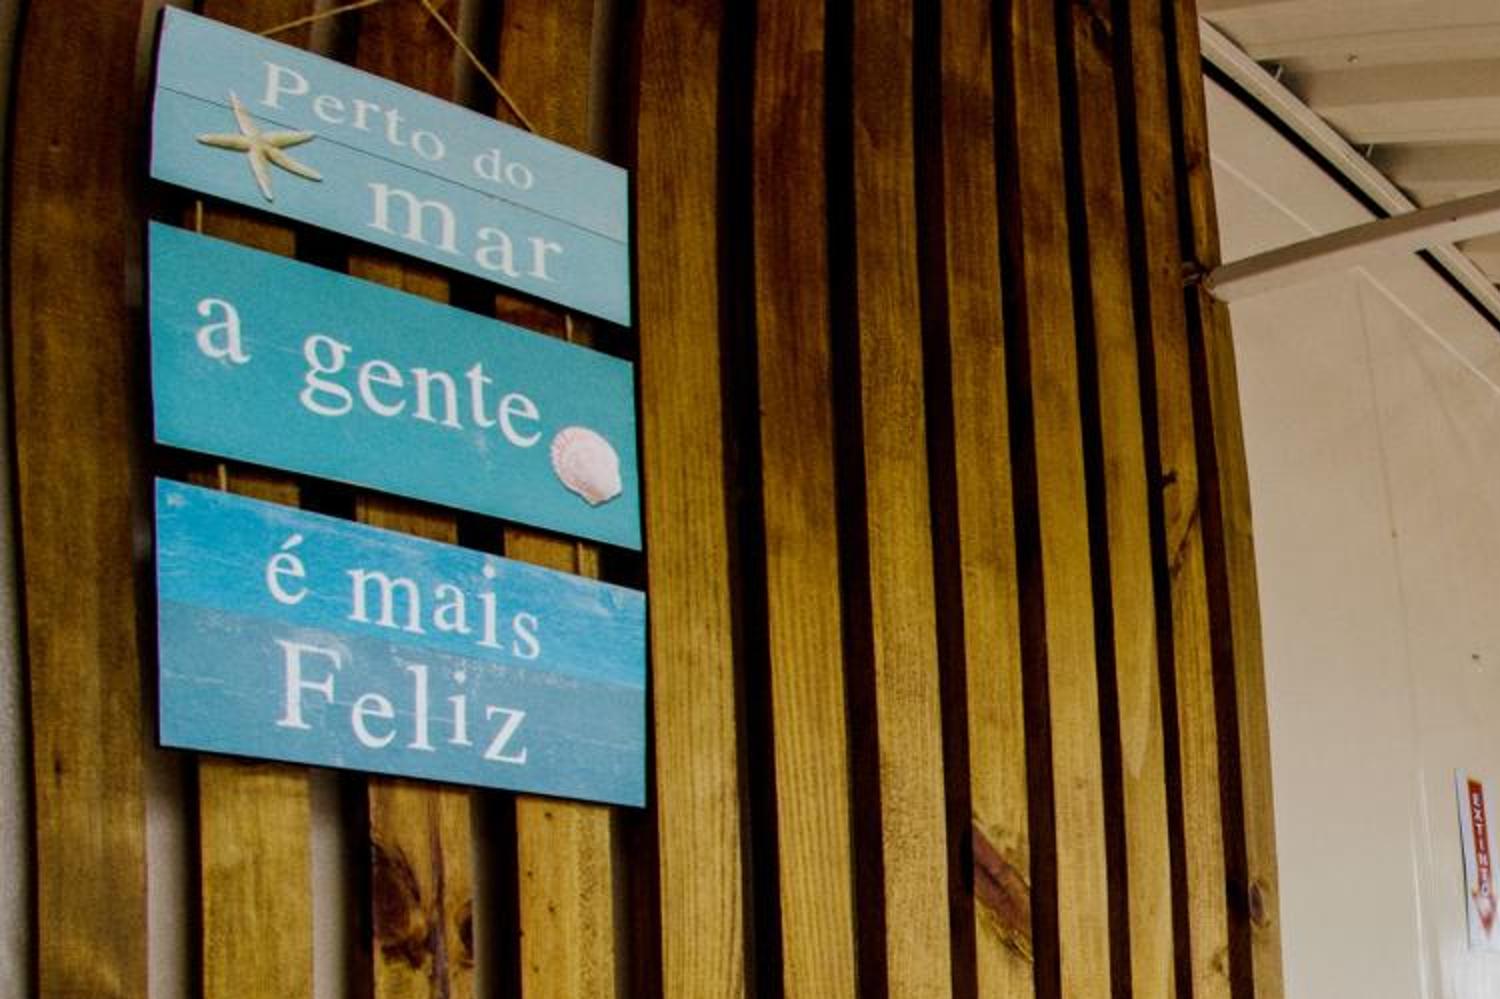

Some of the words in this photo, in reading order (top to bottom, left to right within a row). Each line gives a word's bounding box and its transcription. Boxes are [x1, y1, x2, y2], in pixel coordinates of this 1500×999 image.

[260, 60, 447, 162] Perto
[472, 146, 535, 192] do
[367, 180, 565, 283] mar
[195, 297, 252, 366] a
[299, 331, 543, 448] gente
[265, 533, 310, 606] é
[345, 559, 542, 661] mais
[274, 638, 529, 766] Feliz
[1472, 791, 1492, 908] EXTINTO
